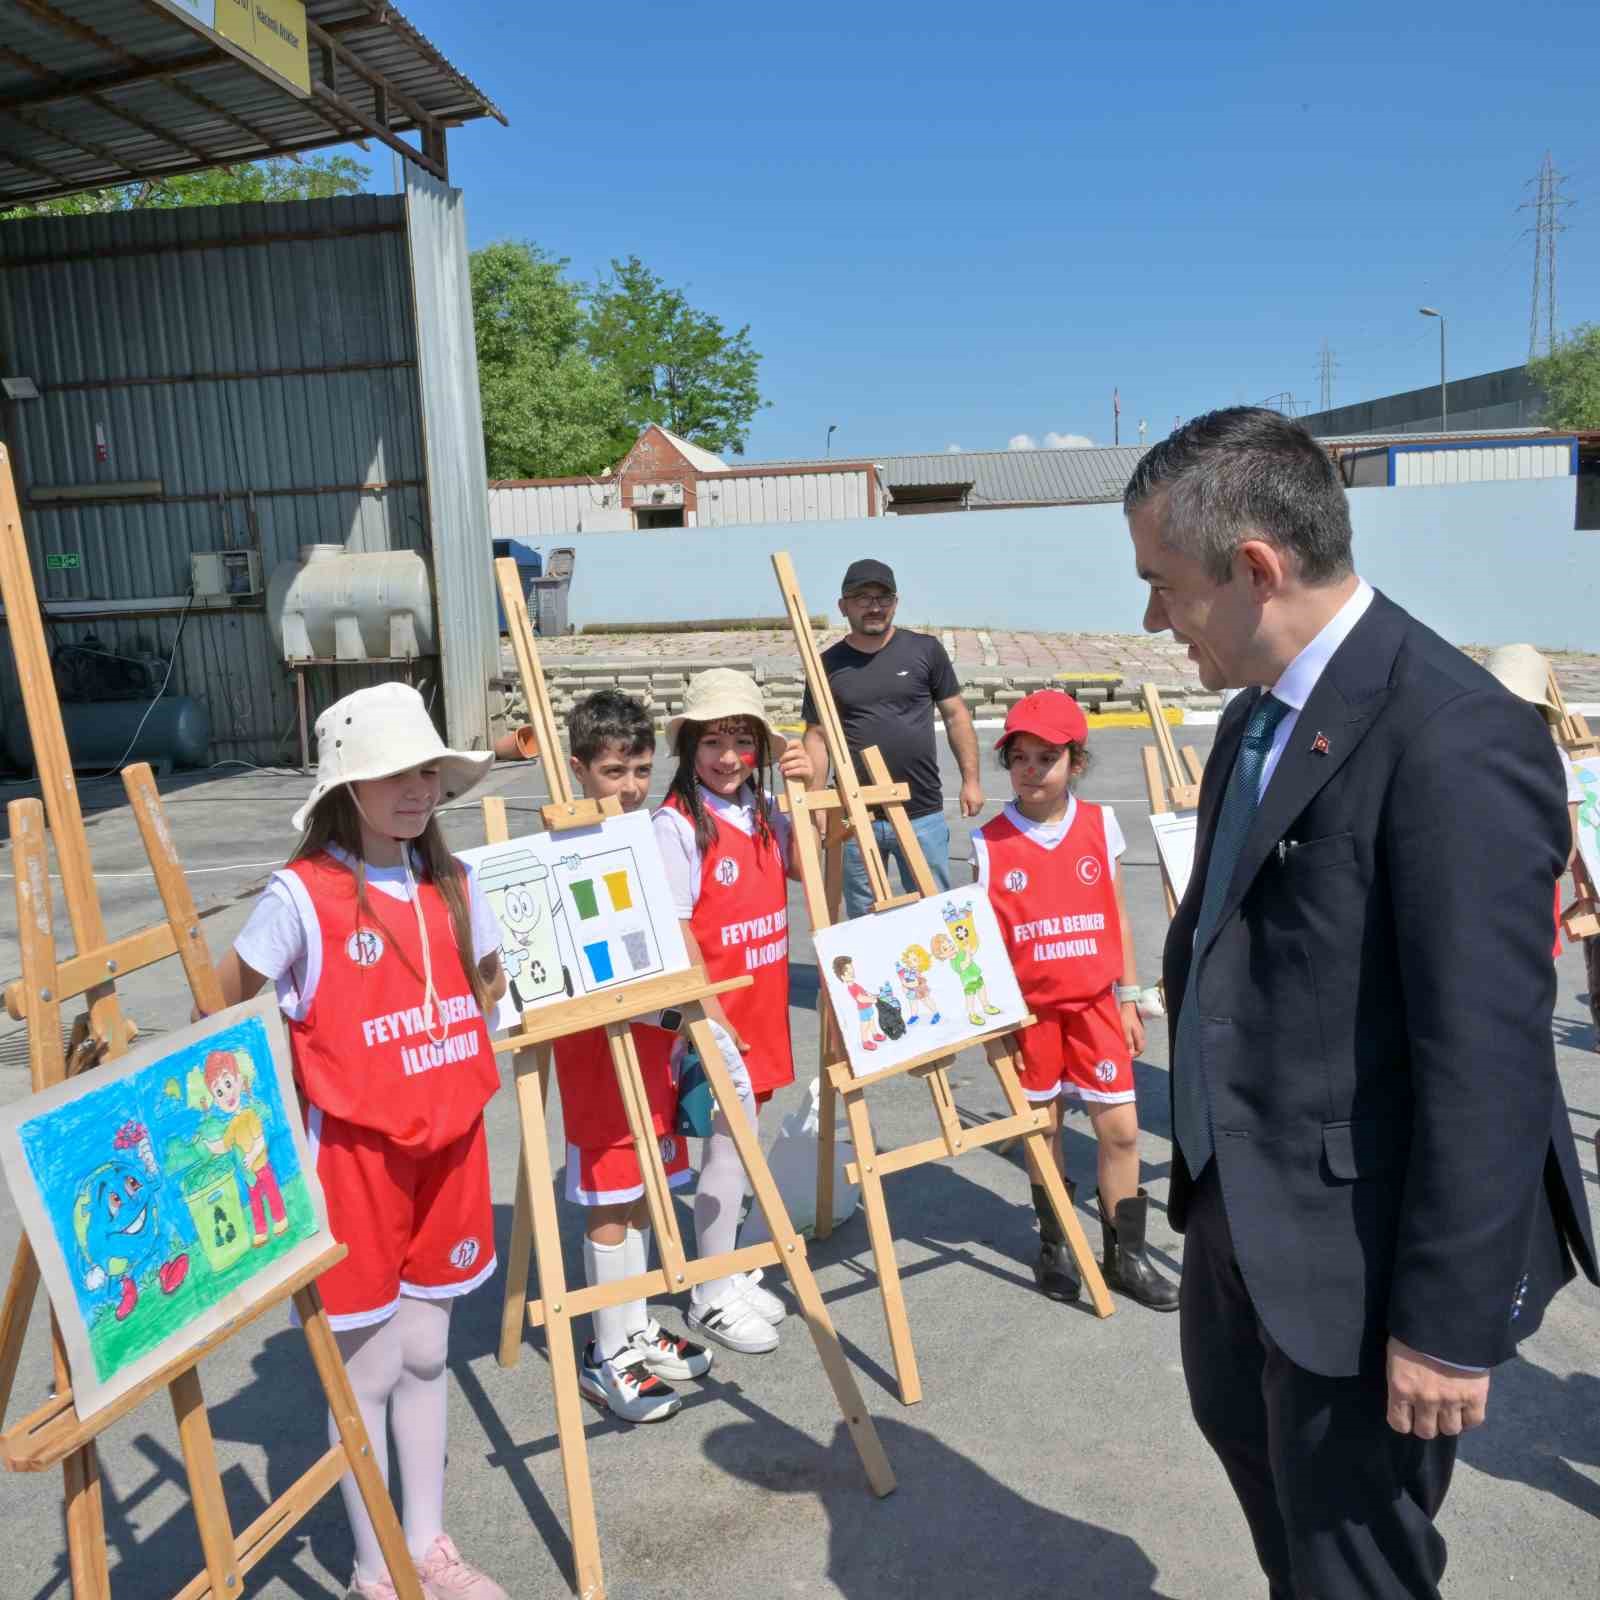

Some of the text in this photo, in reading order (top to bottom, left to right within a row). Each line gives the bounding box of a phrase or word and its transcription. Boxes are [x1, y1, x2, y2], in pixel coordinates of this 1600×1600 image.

[720, 913, 773, 946] FEYYAZ
[1013, 913, 1104, 944] FEYYAZ BERKER
[1033, 937, 1098, 962] İLKOKULU
[361, 1003, 437, 1047] FEYYAZ
[400, 1029, 480, 1077] İLKOKULU
